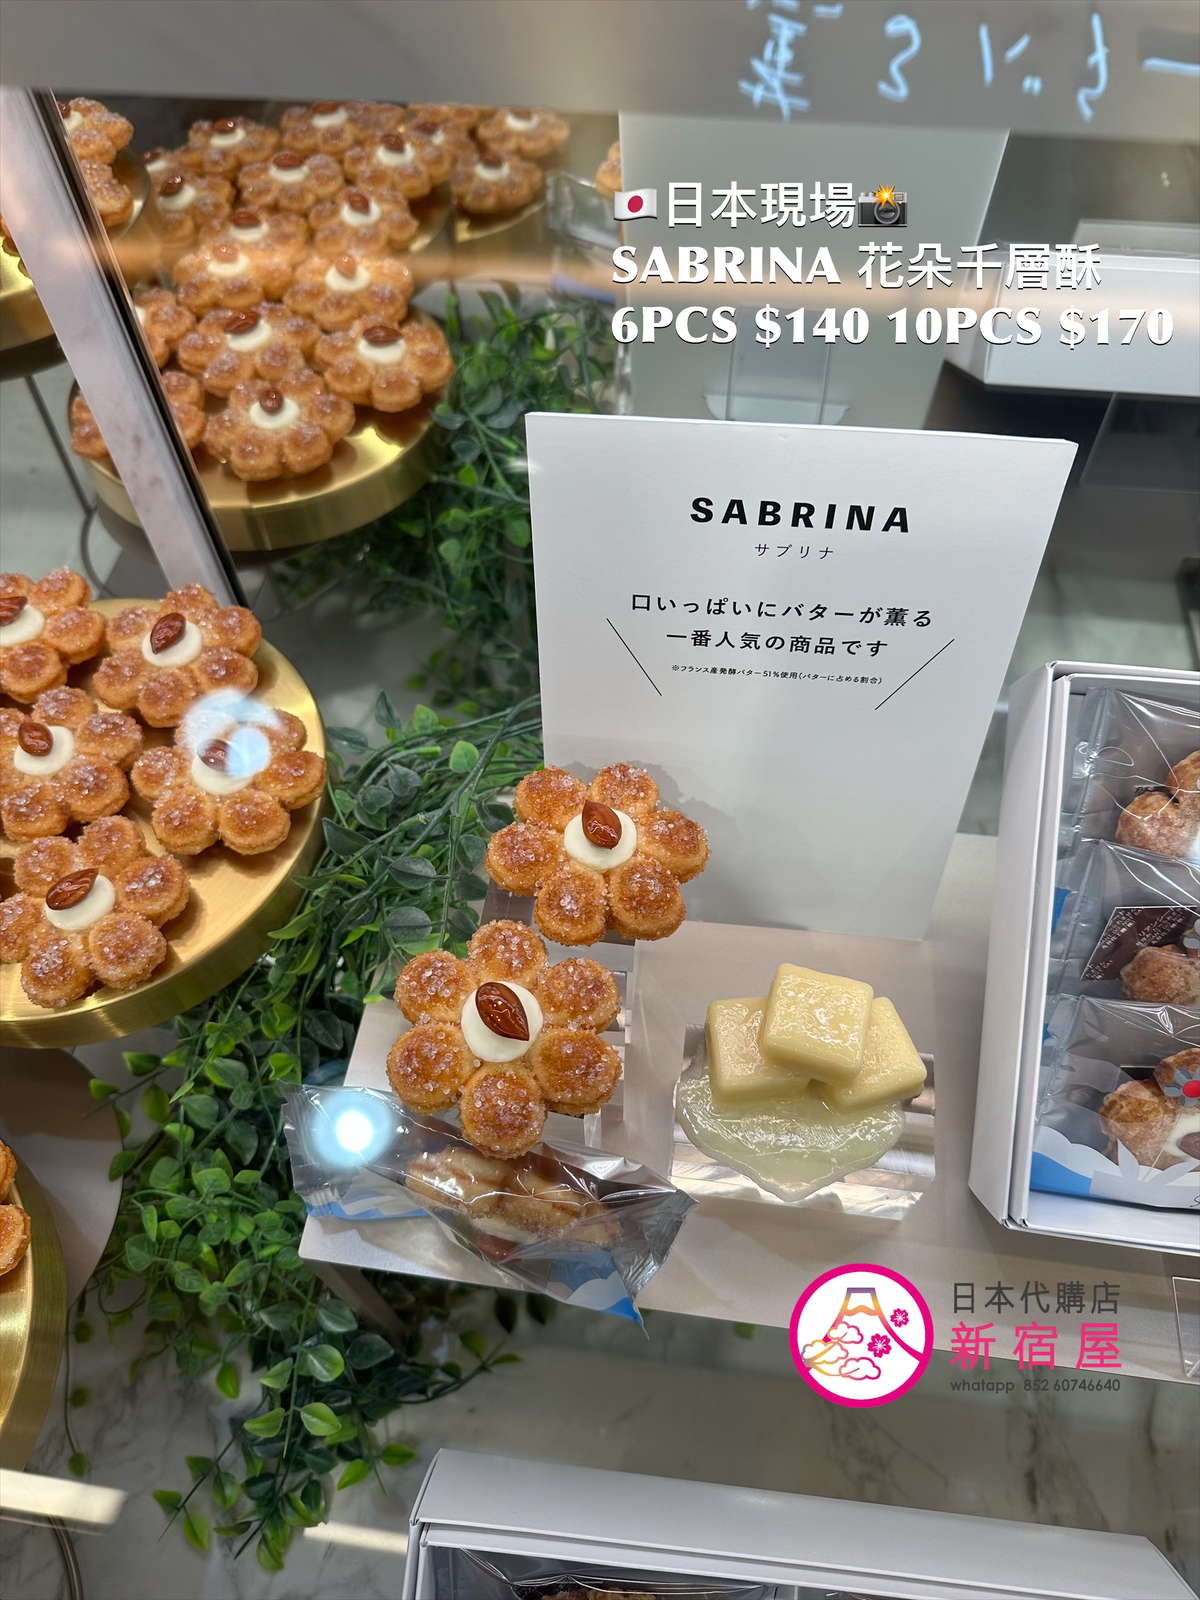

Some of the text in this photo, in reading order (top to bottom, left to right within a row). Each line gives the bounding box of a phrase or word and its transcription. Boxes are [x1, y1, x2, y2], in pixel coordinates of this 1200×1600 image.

[690, 497, 910, 533] SABRINA
[754, 543, 834, 560] サブリナ
[631, 593, 933, 628] 口いっぱいにバターが薫る
[666, 629, 888, 657] 一番人気の商品です
